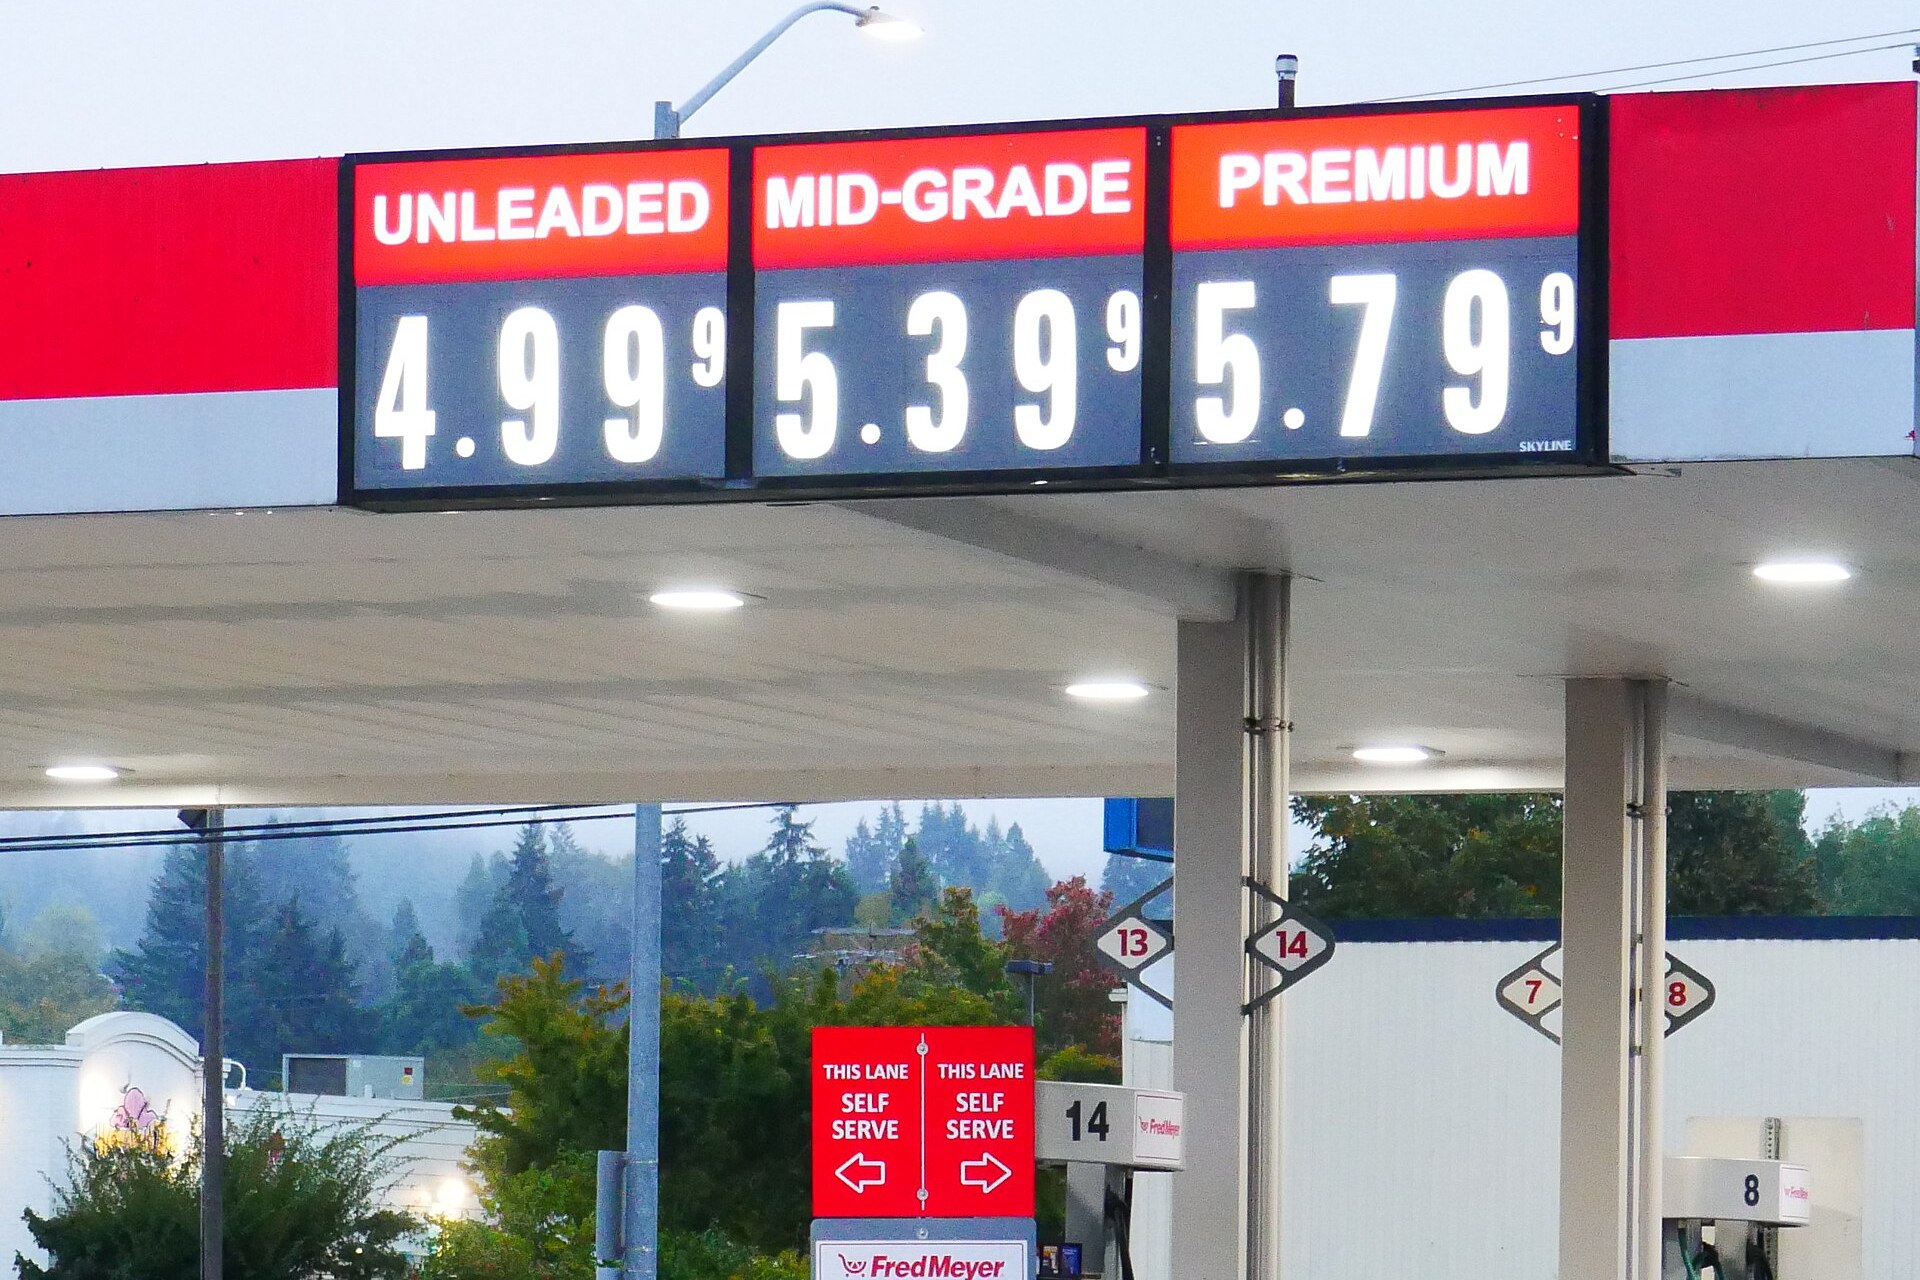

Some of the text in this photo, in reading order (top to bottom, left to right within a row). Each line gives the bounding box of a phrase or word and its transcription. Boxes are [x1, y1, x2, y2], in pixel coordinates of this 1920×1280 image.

[1219, 141, 1529, 208] PREMIUM
[766, 160, 1132, 229] MID-GRADE
[373, 181, 711, 245] UNLEADED
[1519, 440, 1573, 453] SKYLINE
[1117, 928, 1148, 957] 13
[1275, 930, 1309, 959] 14
[1525, 980, 1543, 1004] 7
[1668, 981, 1687, 1007] 8
[823, 1063, 909, 1080] THIS LANE
[937, 1063, 1024, 1080] THIS LANE
[841, 1092, 890, 1113] SELF
[956, 1092, 1005, 1113] SELF
[831, 1119, 899, 1140] SERVE
[946, 1119, 1014, 1140] SERVE
[1065, 1100, 1110, 1142] 14
[1744, 1174, 1760, 1207] 8
